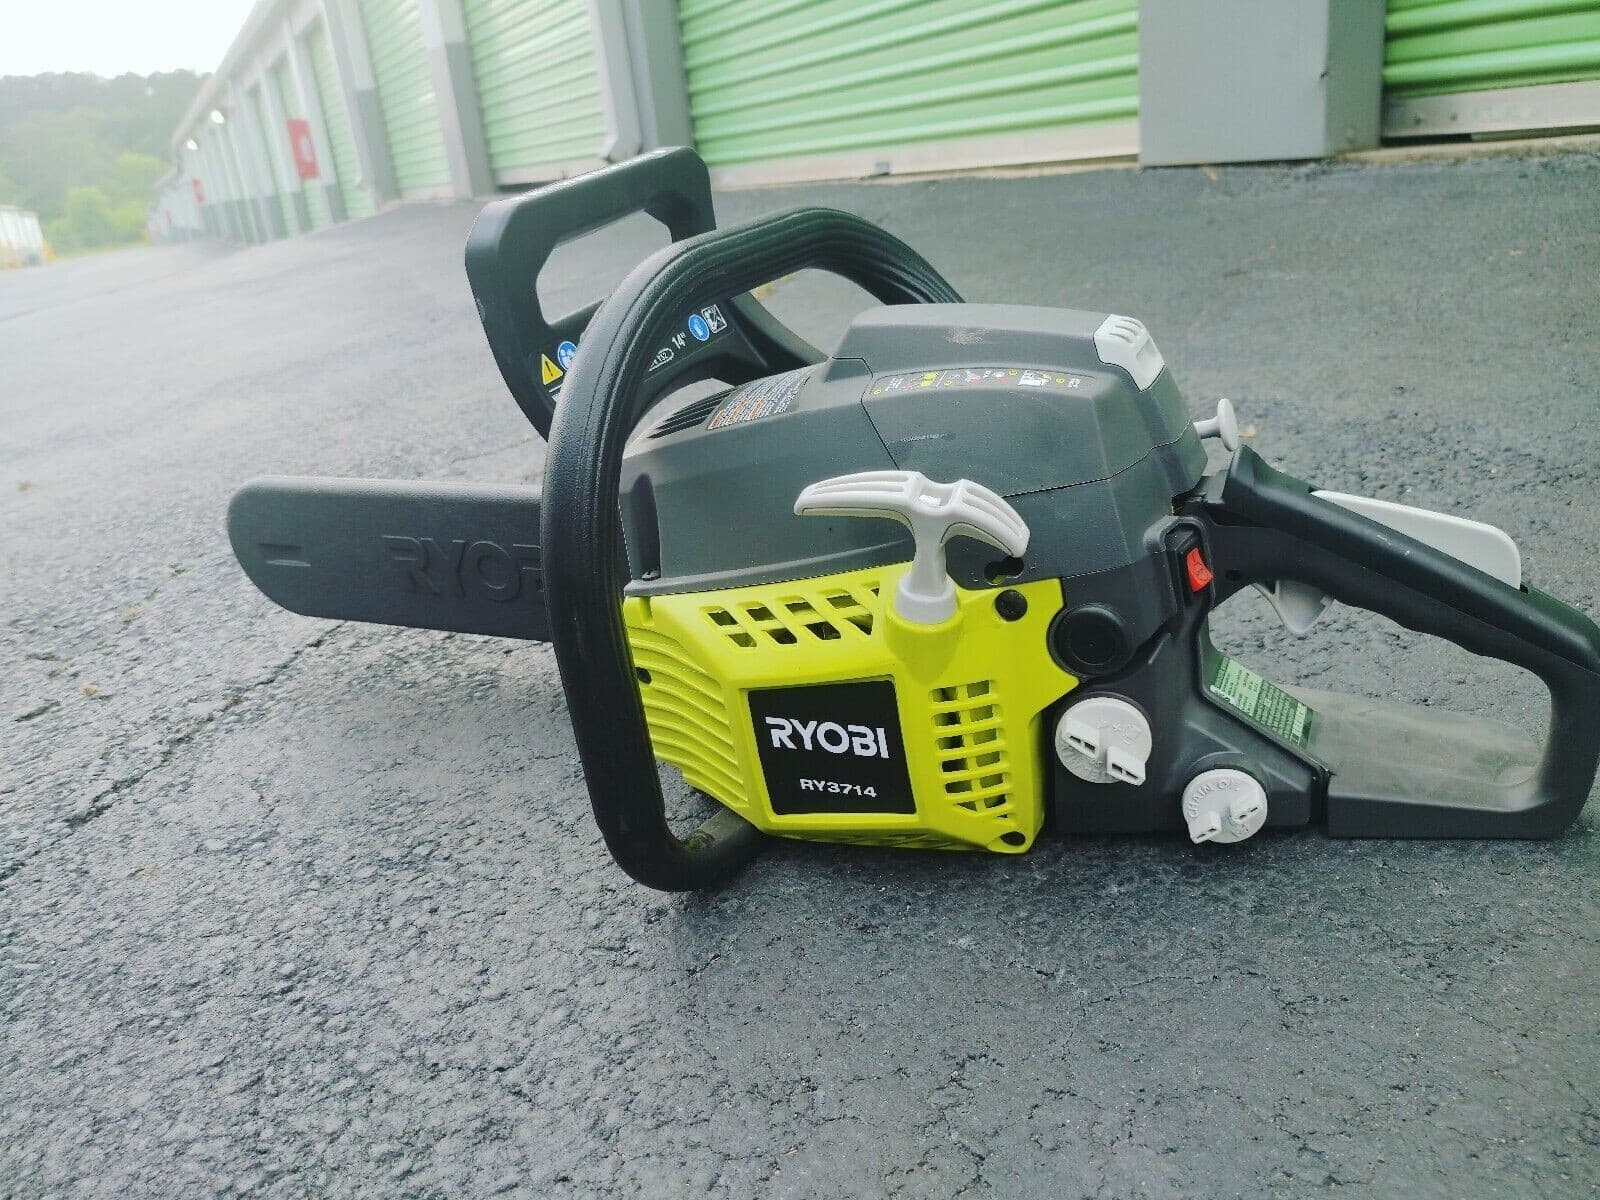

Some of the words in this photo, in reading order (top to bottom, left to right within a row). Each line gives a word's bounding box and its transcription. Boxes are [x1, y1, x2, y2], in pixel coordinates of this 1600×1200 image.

[765, 716, 889, 758] RYOBI
[799, 778, 877, 798] RY3714
[1186, 784, 1213, 818] CHAIN
